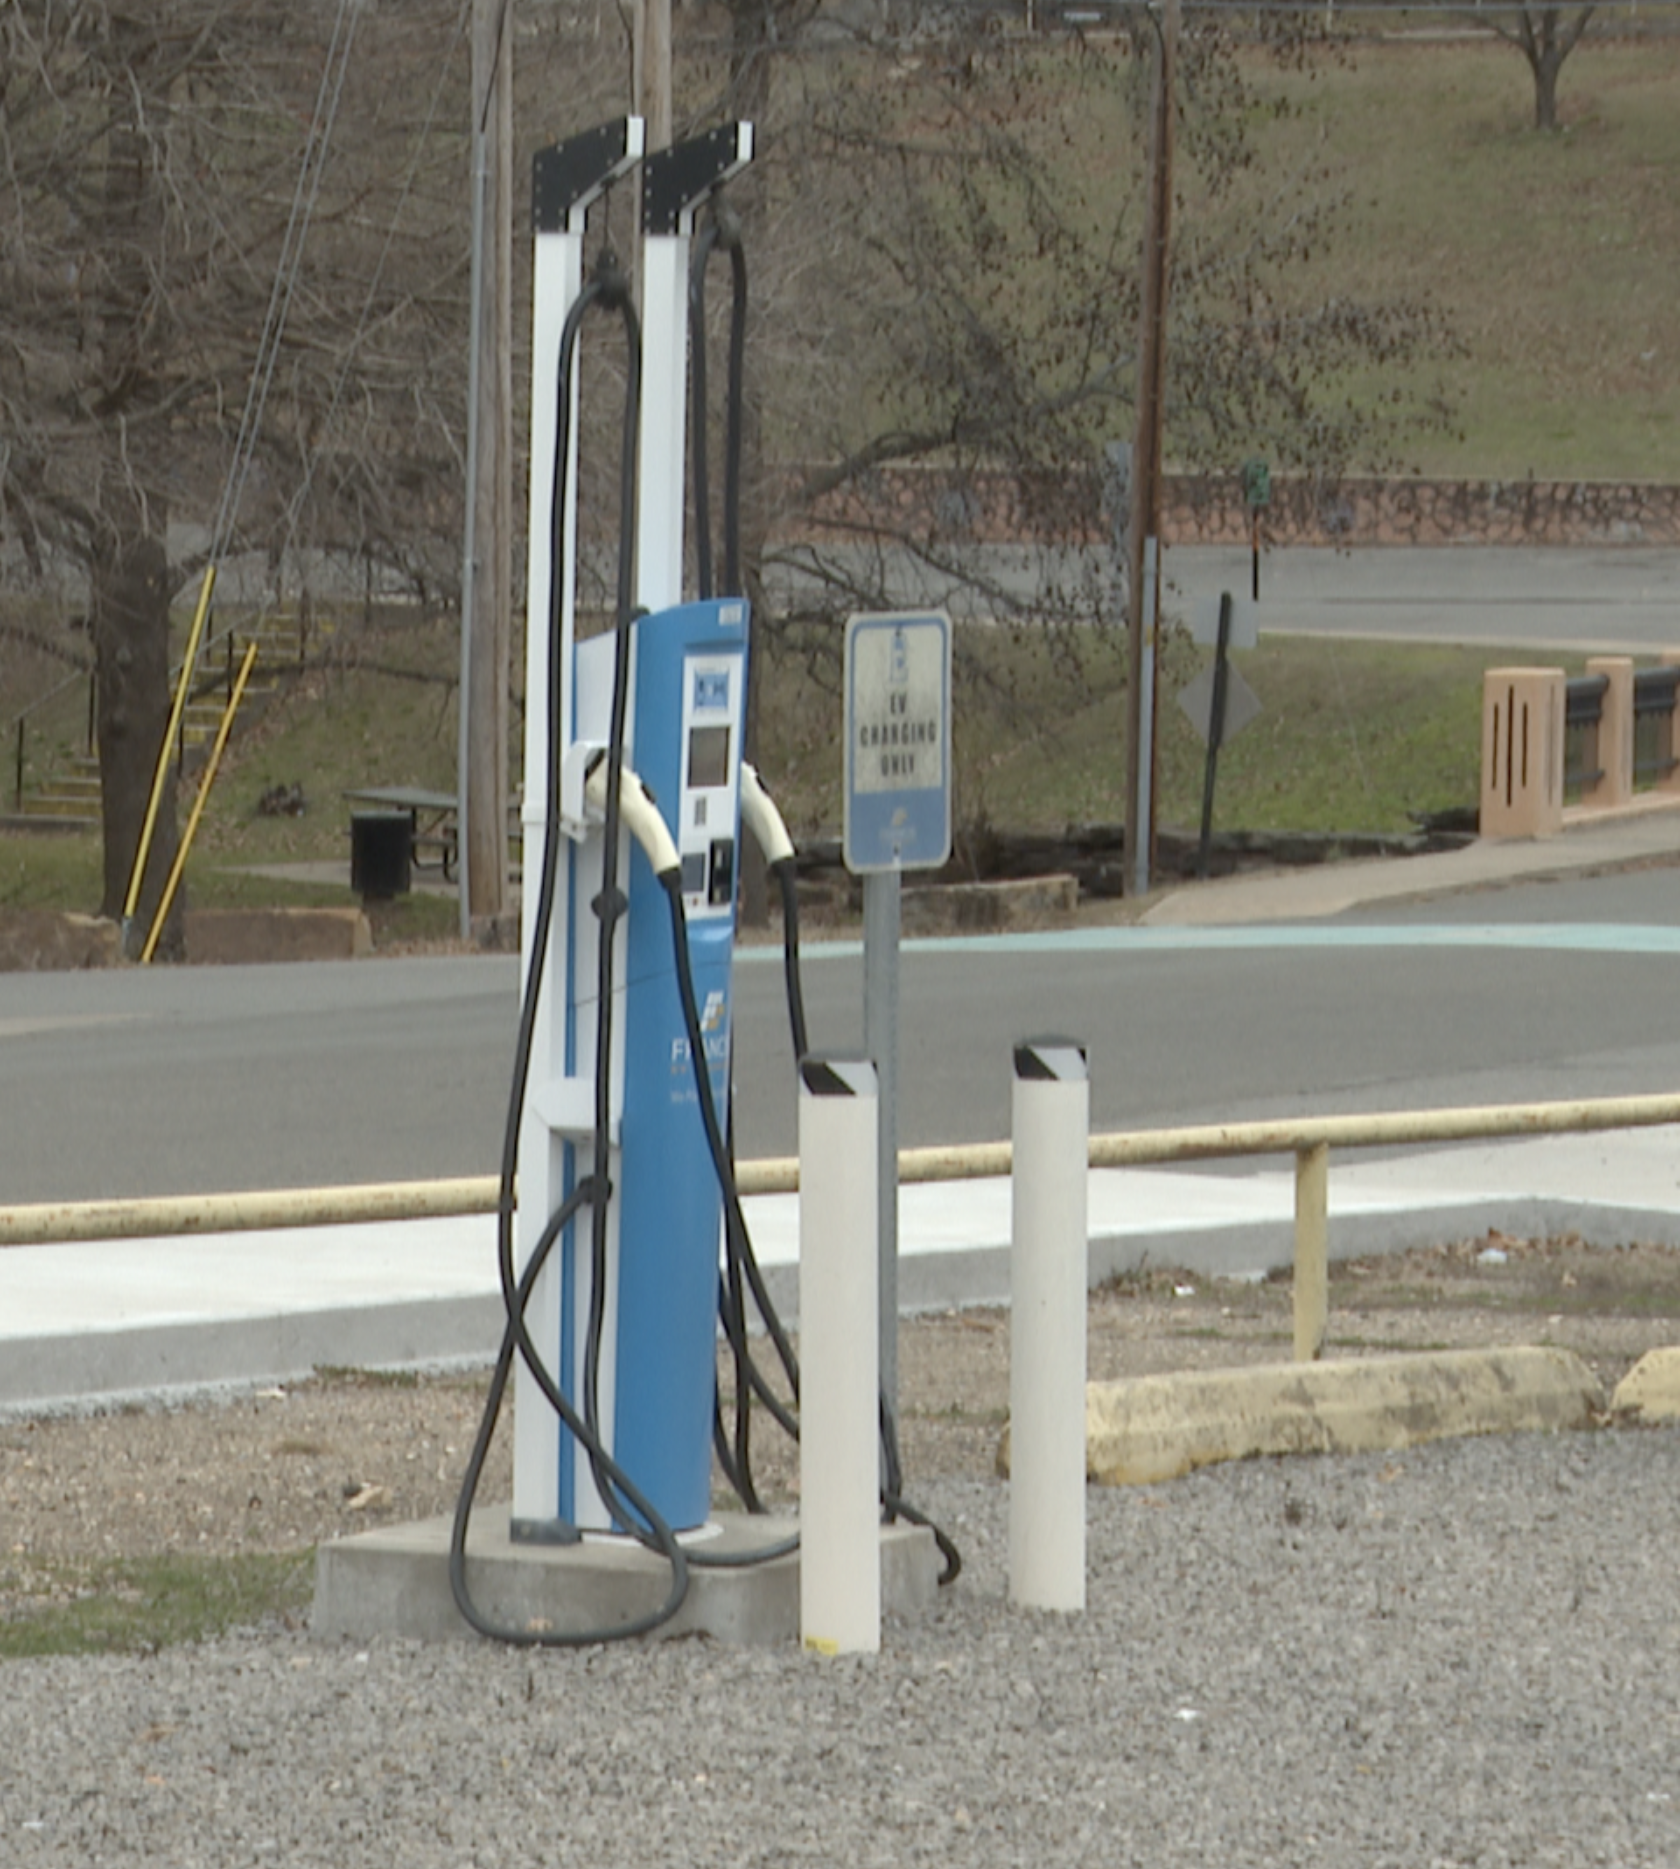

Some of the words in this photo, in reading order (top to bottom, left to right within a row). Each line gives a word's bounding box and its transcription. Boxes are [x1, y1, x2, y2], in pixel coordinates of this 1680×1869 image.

[891, 693, 907, 715] EV
[861, 720, 936, 747] CHARGING
[880, 753, 915, 777] ONLY
